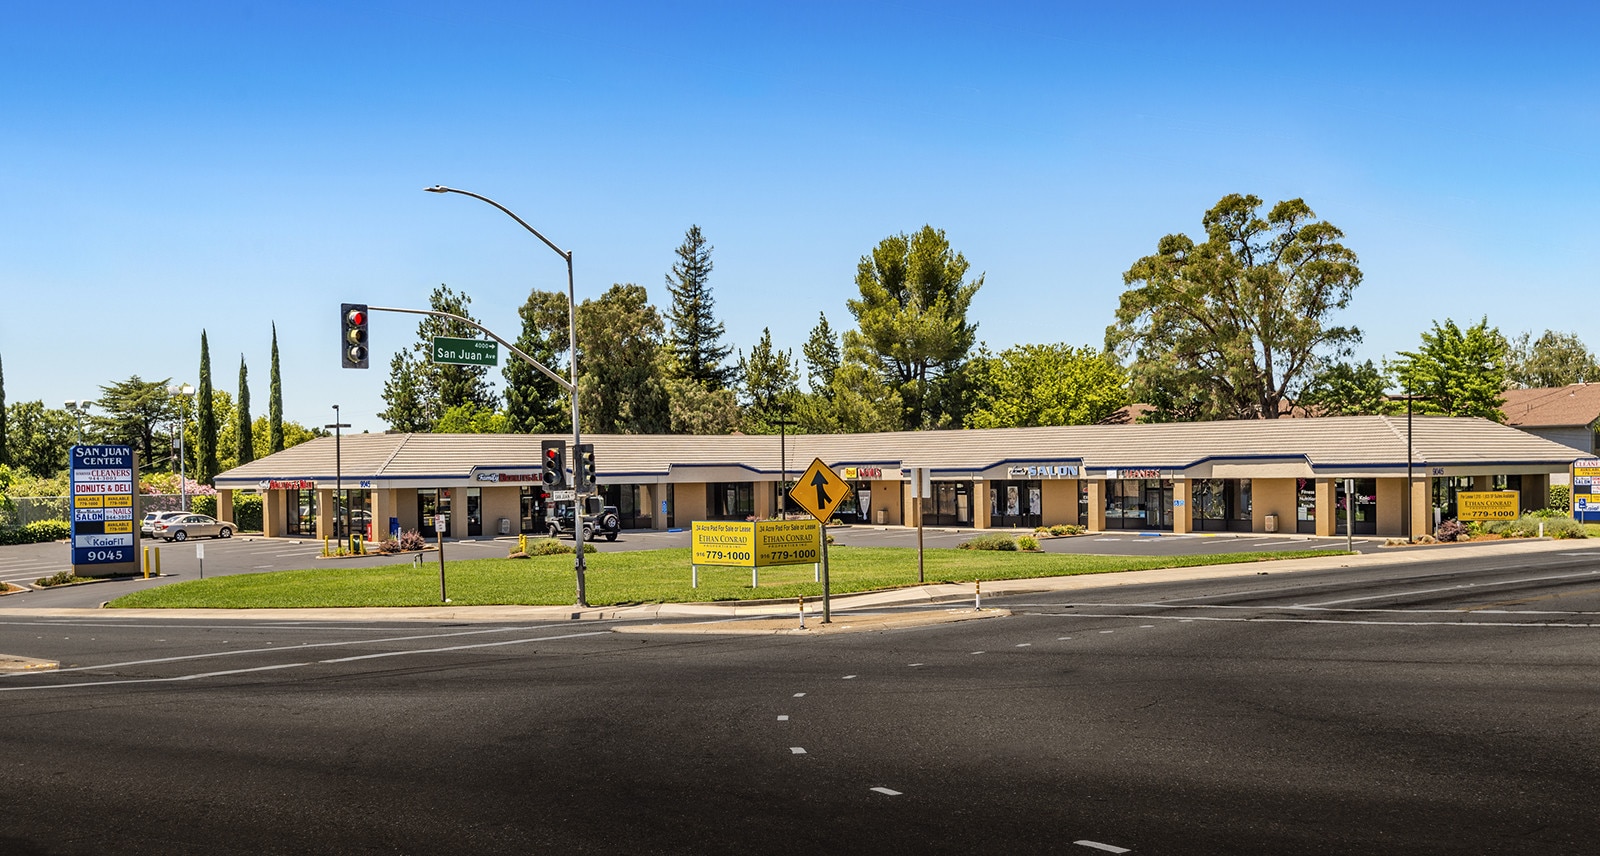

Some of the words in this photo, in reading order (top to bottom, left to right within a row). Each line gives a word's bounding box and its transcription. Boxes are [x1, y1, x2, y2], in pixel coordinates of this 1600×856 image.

[437, 347, 456, 358] San
[459, 349, 482, 360] Juan
[76, 447, 100, 457] SAN
[101, 447, 130, 457] JUAN
[83, 457, 123, 465] CENTER
[1027, 466, 1079, 476] SALON
[1432, 467, 1445, 475] 9045
[76, 484, 106, 493] DONUTS
[115, 484, 131, 492] DELI
[699, 534, 719, 542] ETHAN
[720, 535, 748, 543] CONRAD
[763, 535, 784, 543] ETHAN
[786, 534, 813, 542] CONRAD
[87, 550, 123, 561] 9045
[706, 550, 751, 560] 779-1000
[771, 549, 816, 560] 779-1000
